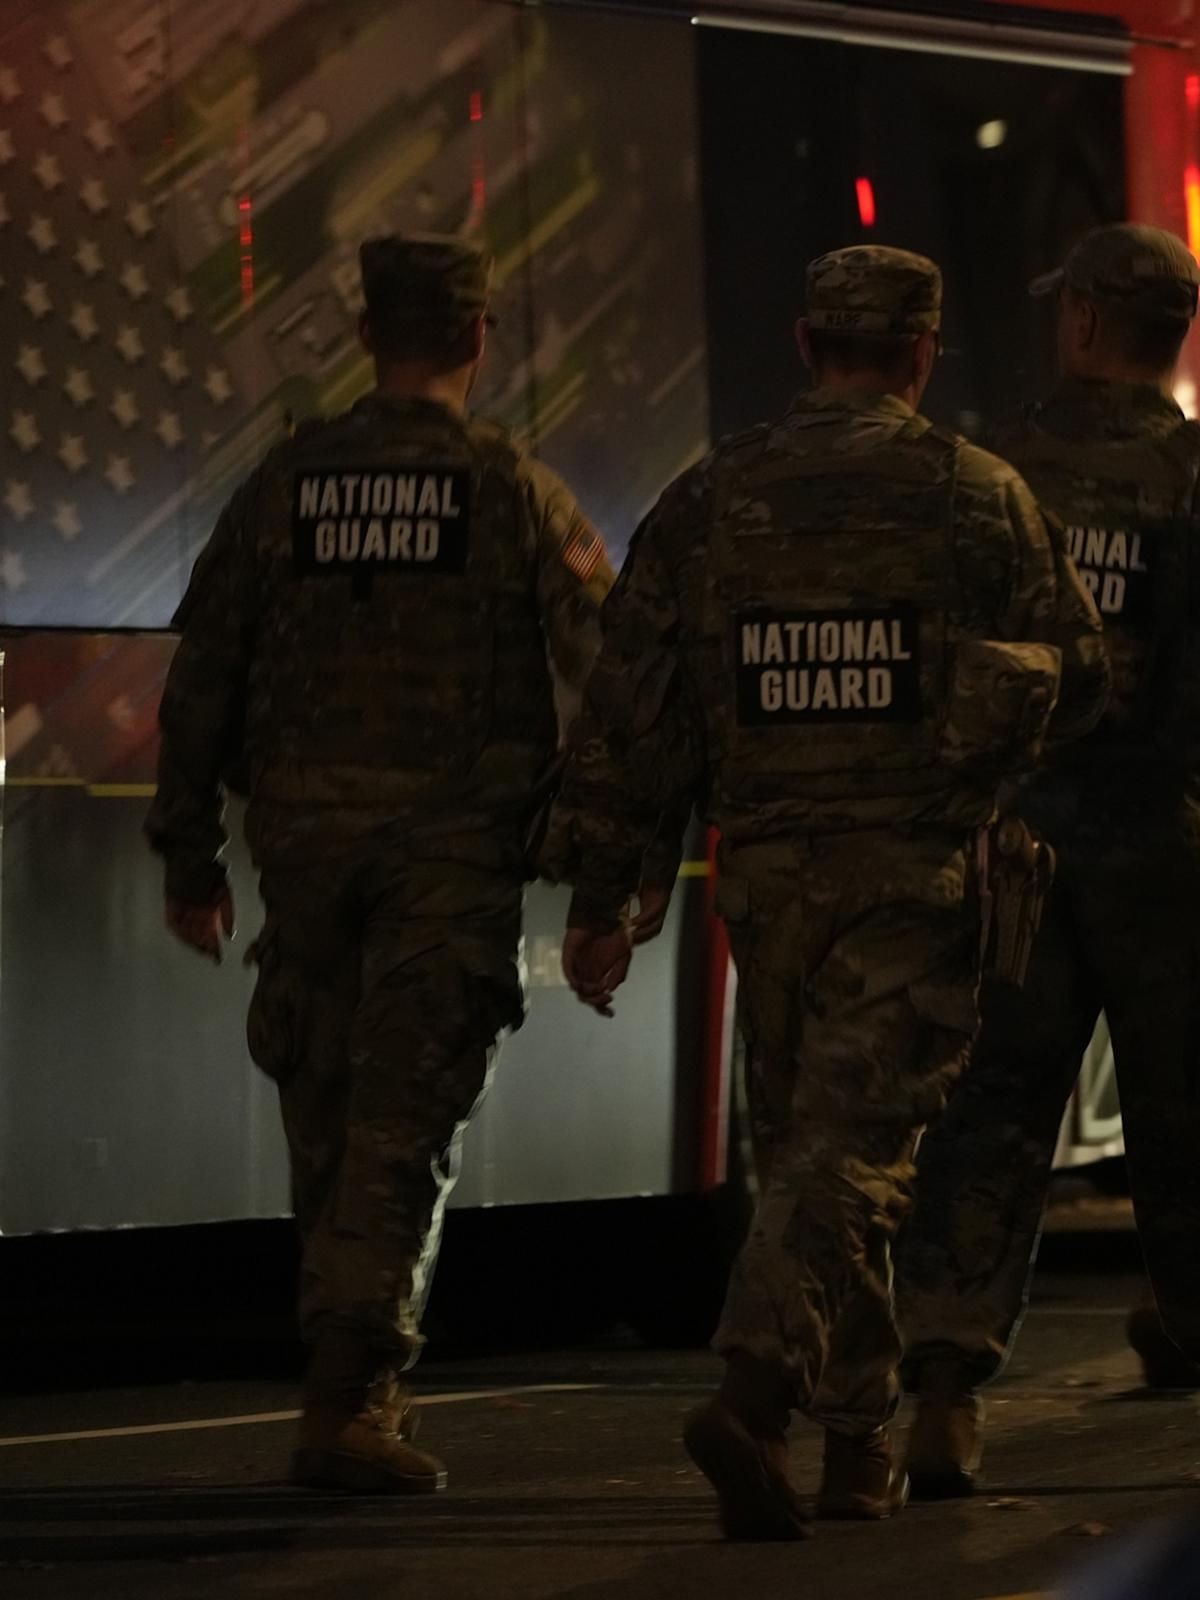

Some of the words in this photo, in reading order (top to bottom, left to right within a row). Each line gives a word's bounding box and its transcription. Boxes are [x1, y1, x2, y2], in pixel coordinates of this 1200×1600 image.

[299, 472, 461, 520] NATIONAL
[314, 517, 440, 564] GUARD
[1065, 525, 1147, 573] ONAL
[741, 619, 912, 665] NATIONAL
[760, 666, 893, 712] GUARD
